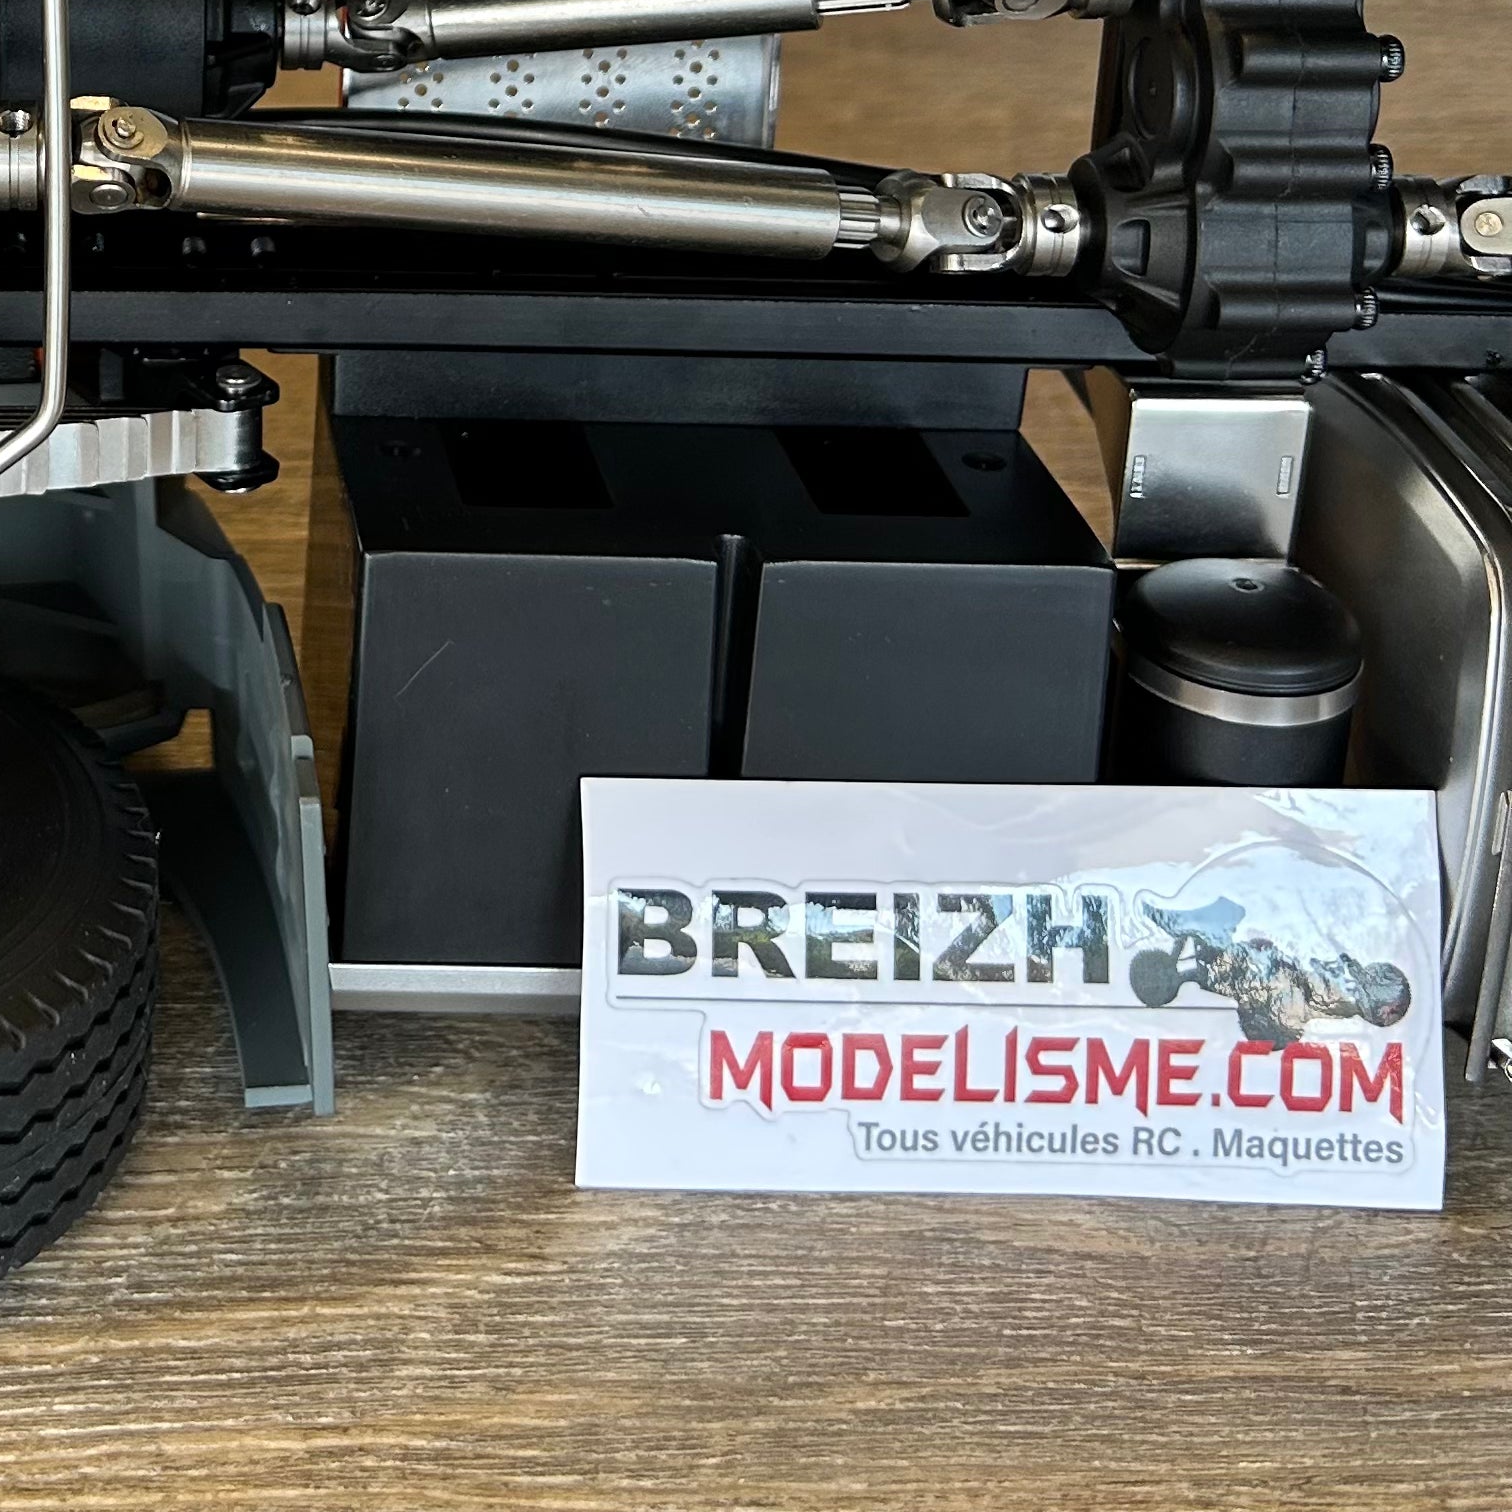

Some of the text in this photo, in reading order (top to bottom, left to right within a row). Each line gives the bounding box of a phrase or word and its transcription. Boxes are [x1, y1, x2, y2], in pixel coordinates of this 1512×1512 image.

[617, 887, 1110, 984] BREIZH
[709, 1024, 1404, 1126] MODELISME.COM
[857, 1122, 939, 1153] Tous
[949, 1122, 1120, 1157] véhicules
[1131, 1126, 1182, 1157] RC
[1212, 1127, 1405, 1167] Maquettes
